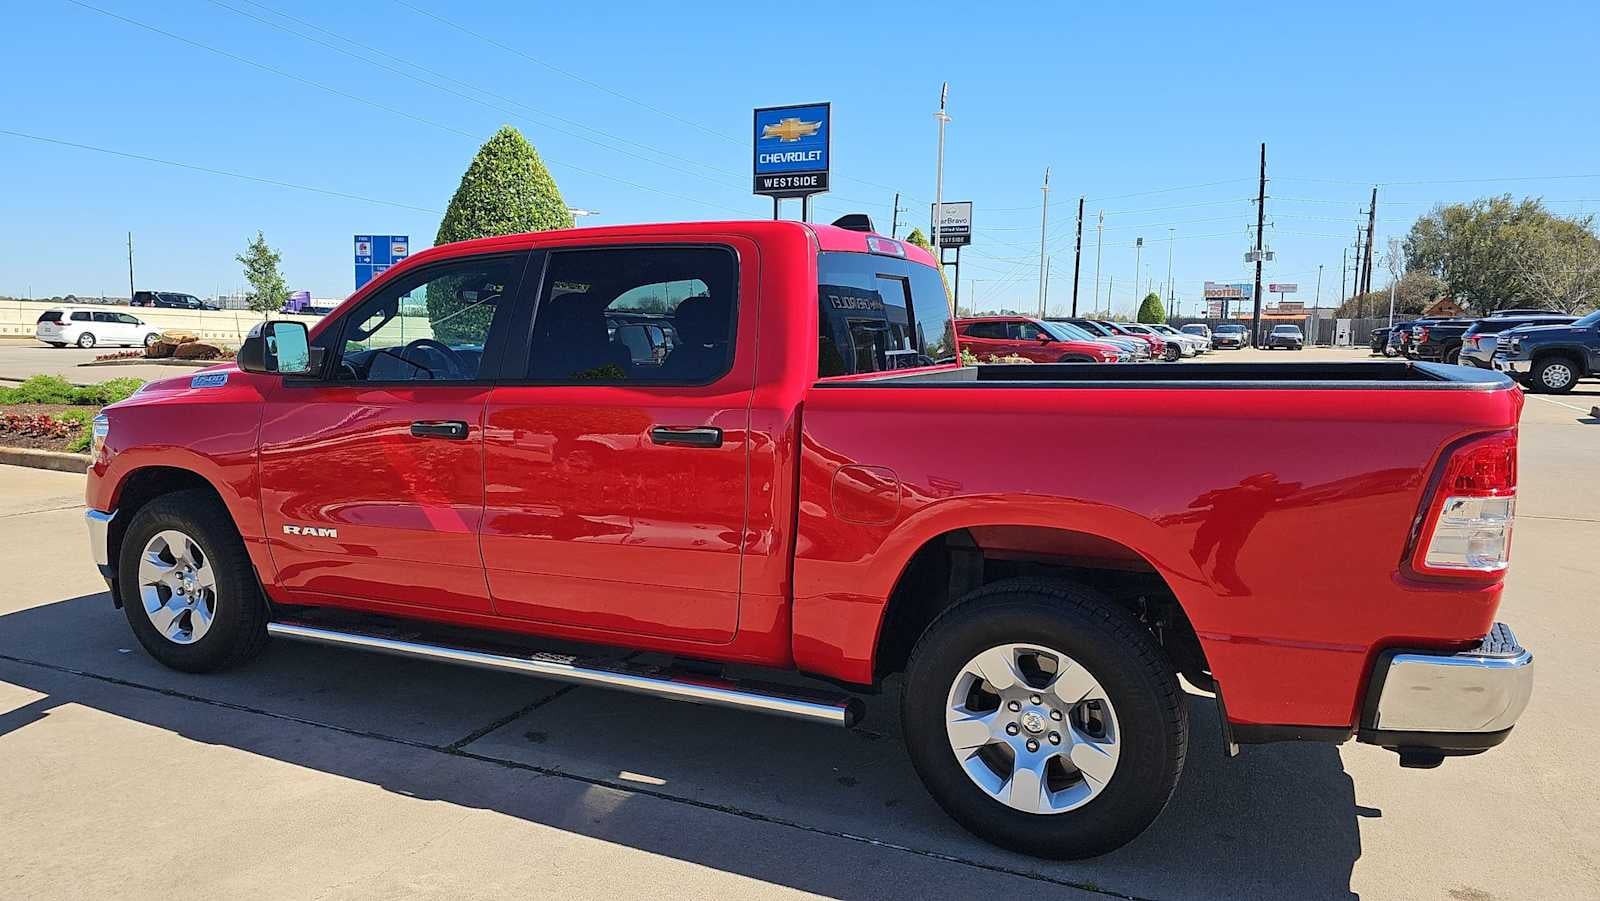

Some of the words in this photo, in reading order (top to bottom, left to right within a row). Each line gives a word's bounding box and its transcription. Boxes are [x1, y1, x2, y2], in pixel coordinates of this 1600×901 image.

[760, 150, 821, 164] CHEVROLET
[764, 176, 817, 188] WESTSIDE
[283, 525, 337, 539] RAM
